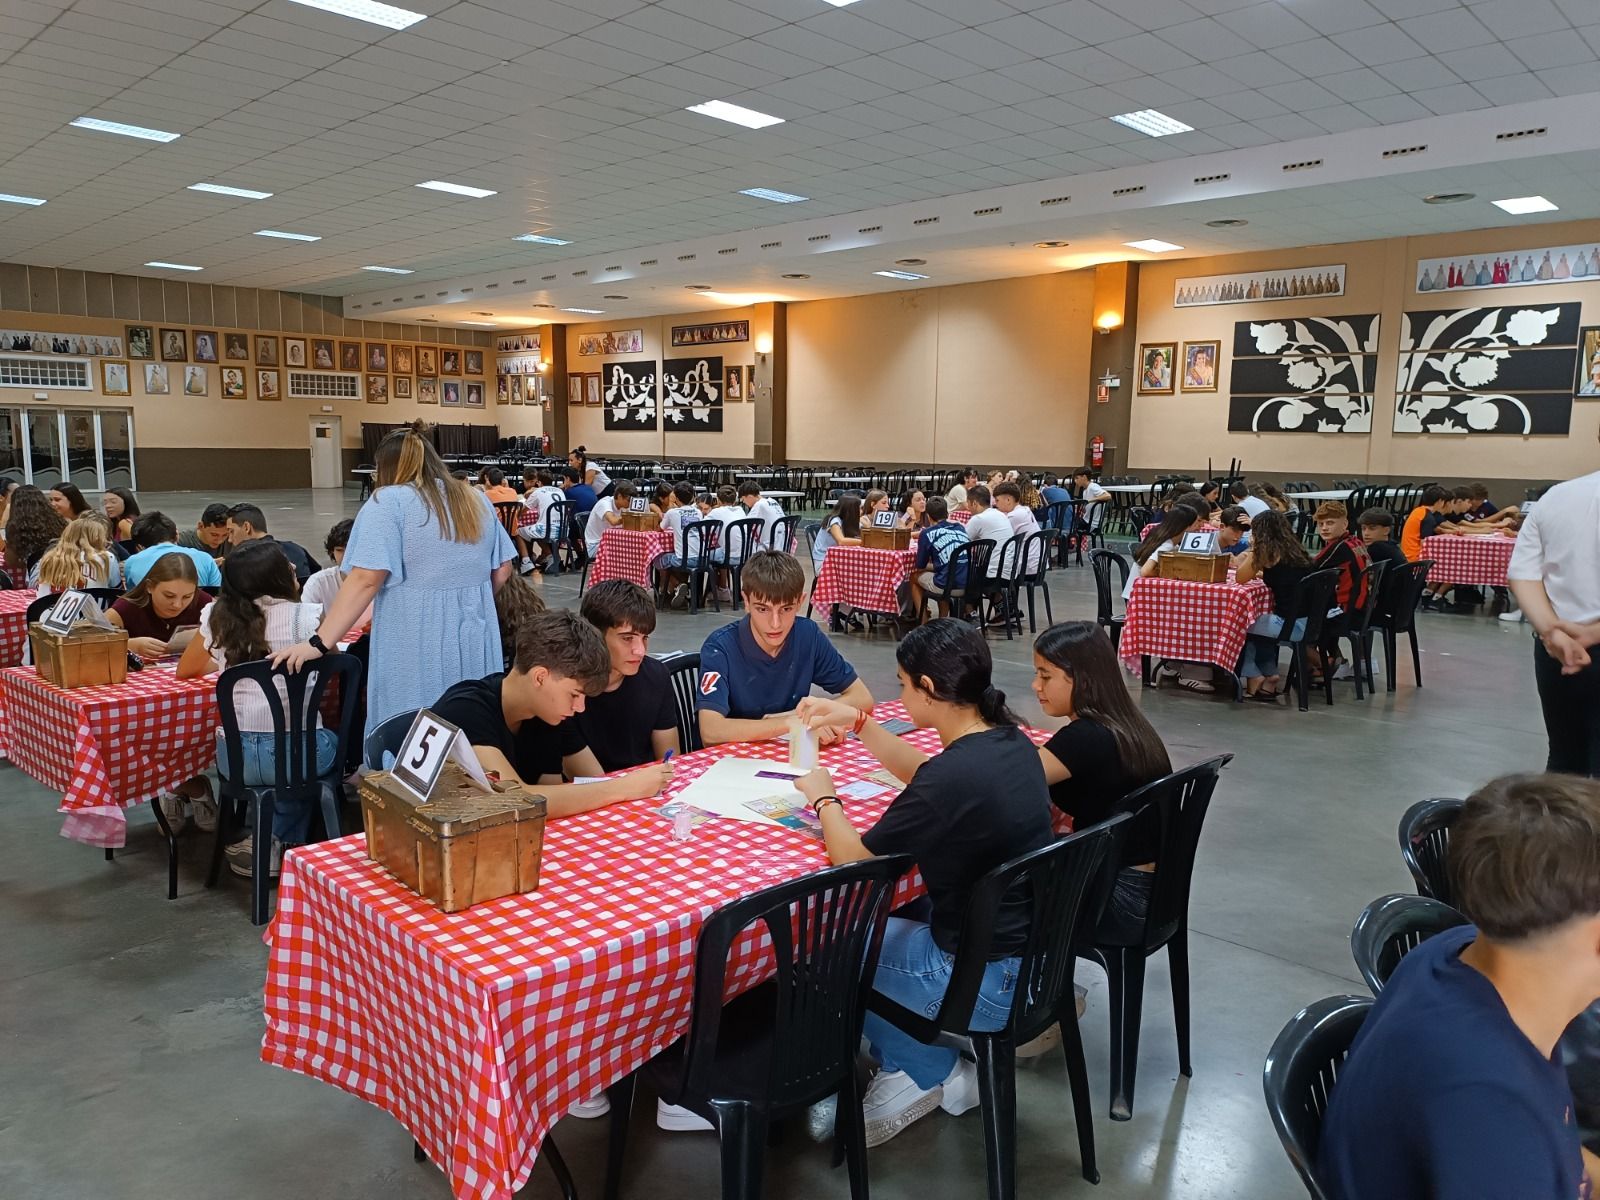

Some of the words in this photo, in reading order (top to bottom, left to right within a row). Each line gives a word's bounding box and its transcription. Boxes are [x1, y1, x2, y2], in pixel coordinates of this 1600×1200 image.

[633, 499, 643, 509] 13
[879, 513, 891, 524] 19
[1190, 535, 1202, 549] 6
[56, 596, 79, 621] 10
[411, 725, 439, 770] 5
